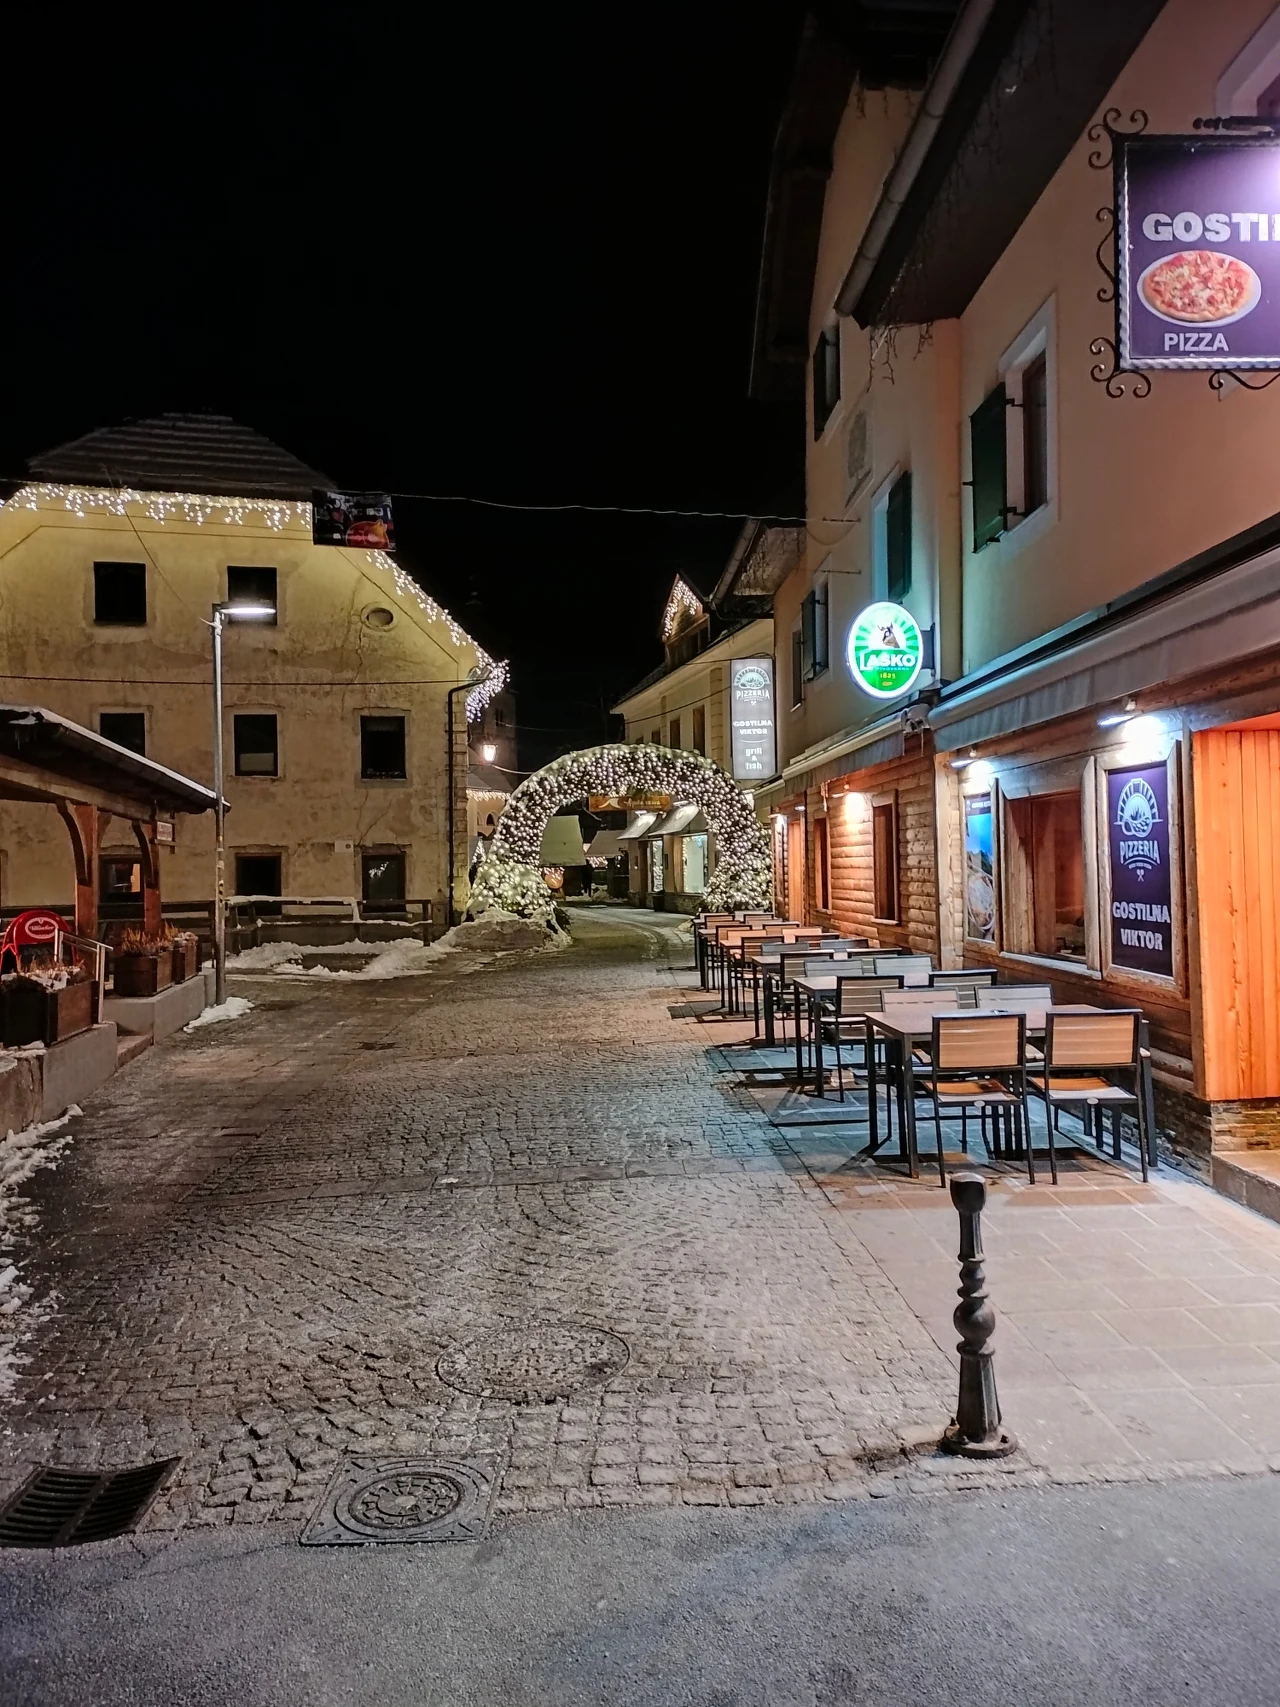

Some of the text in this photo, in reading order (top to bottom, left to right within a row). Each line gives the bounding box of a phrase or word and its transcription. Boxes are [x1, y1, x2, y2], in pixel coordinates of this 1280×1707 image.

[1164, 333, 1229, 352] PIZZA
[860, 651, 916, 671] LAŠKO
[735, 689, 770, 700] PIZZERIA
[745, 747, 762, 757] grill
[745, 761, 762, 771] fish
[1119, 840, 1161, 864] PIZZERIA
[1112, 901, 1171, 924] GOSTILNA
[1120, 928, 1163, 951] VIKTOR
